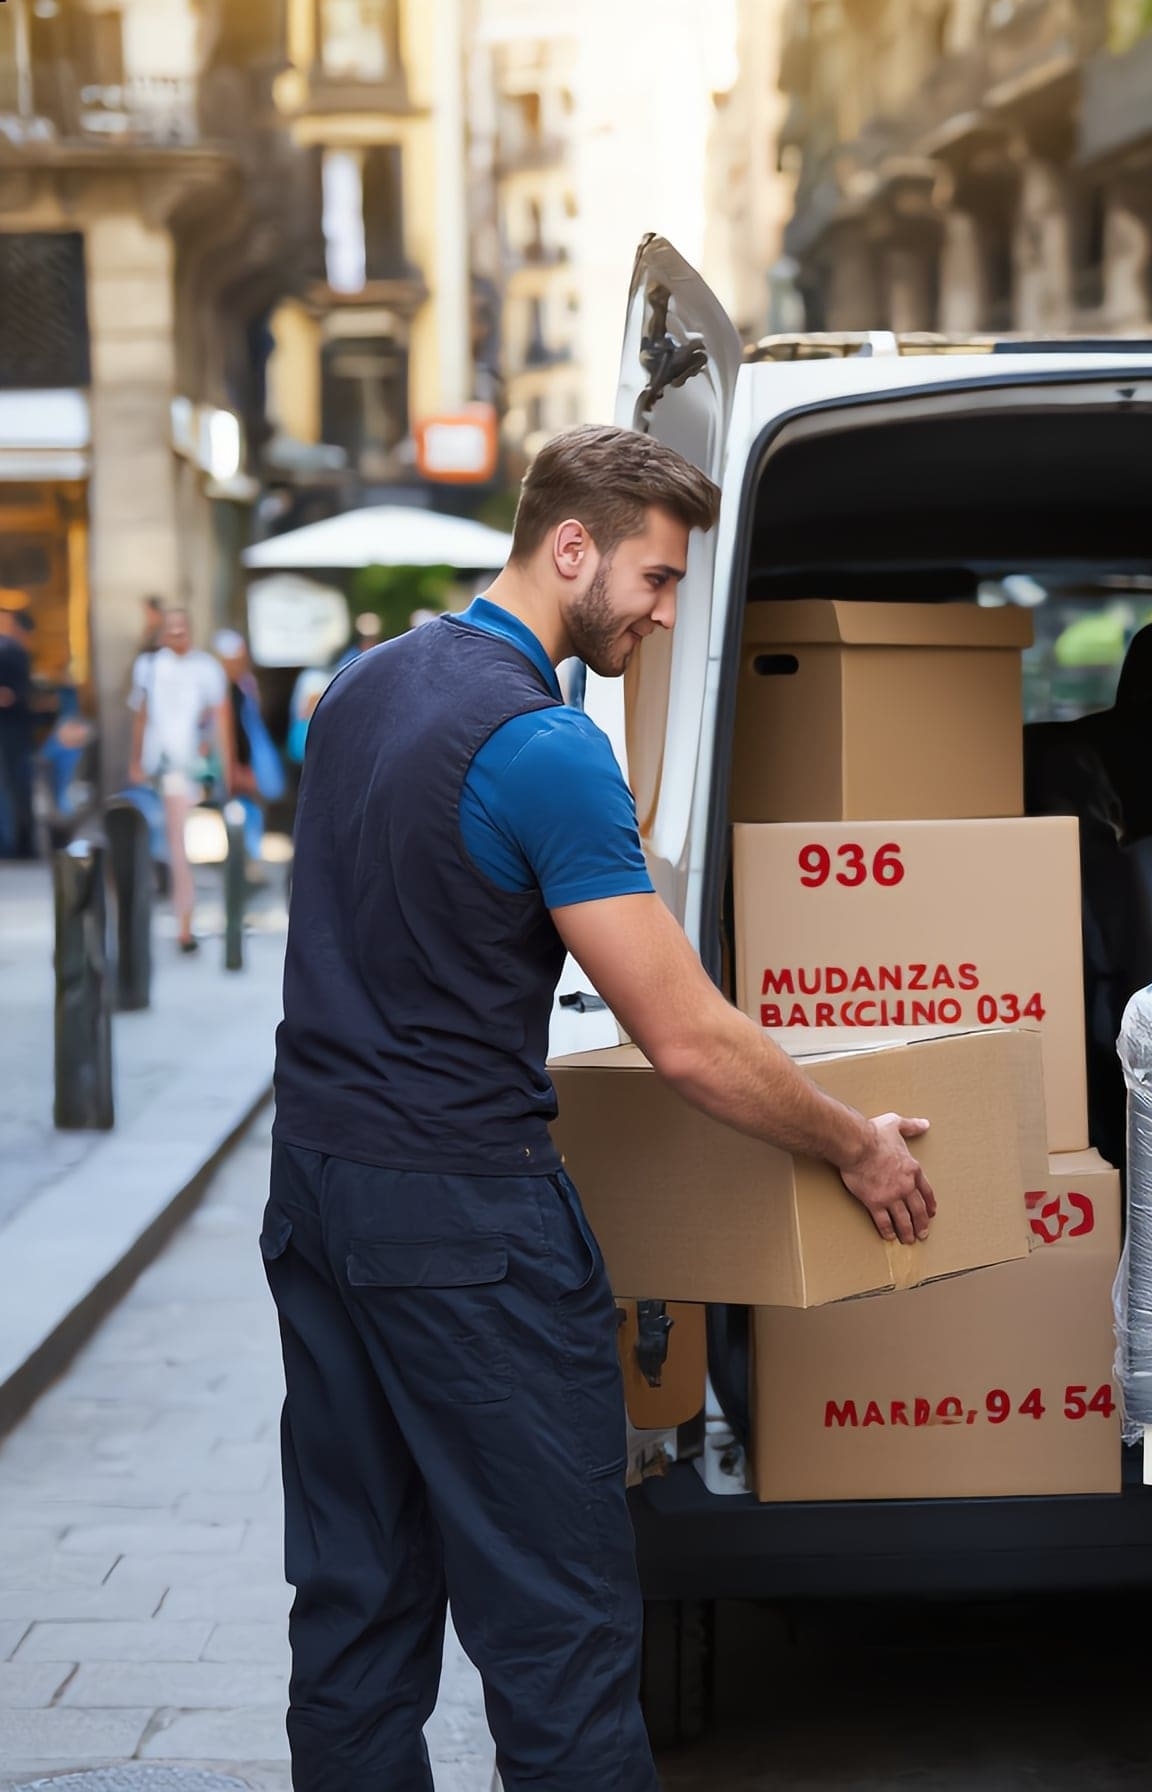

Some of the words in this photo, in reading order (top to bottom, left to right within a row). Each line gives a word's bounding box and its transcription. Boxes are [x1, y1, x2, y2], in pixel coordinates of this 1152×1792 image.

[798, 842, 905, 888] 936
[761, 963, 980, 996] MUDANZAS
[977, 992, 1047, 1025] 034
[1063, 1384, 1117, 1420] 54
